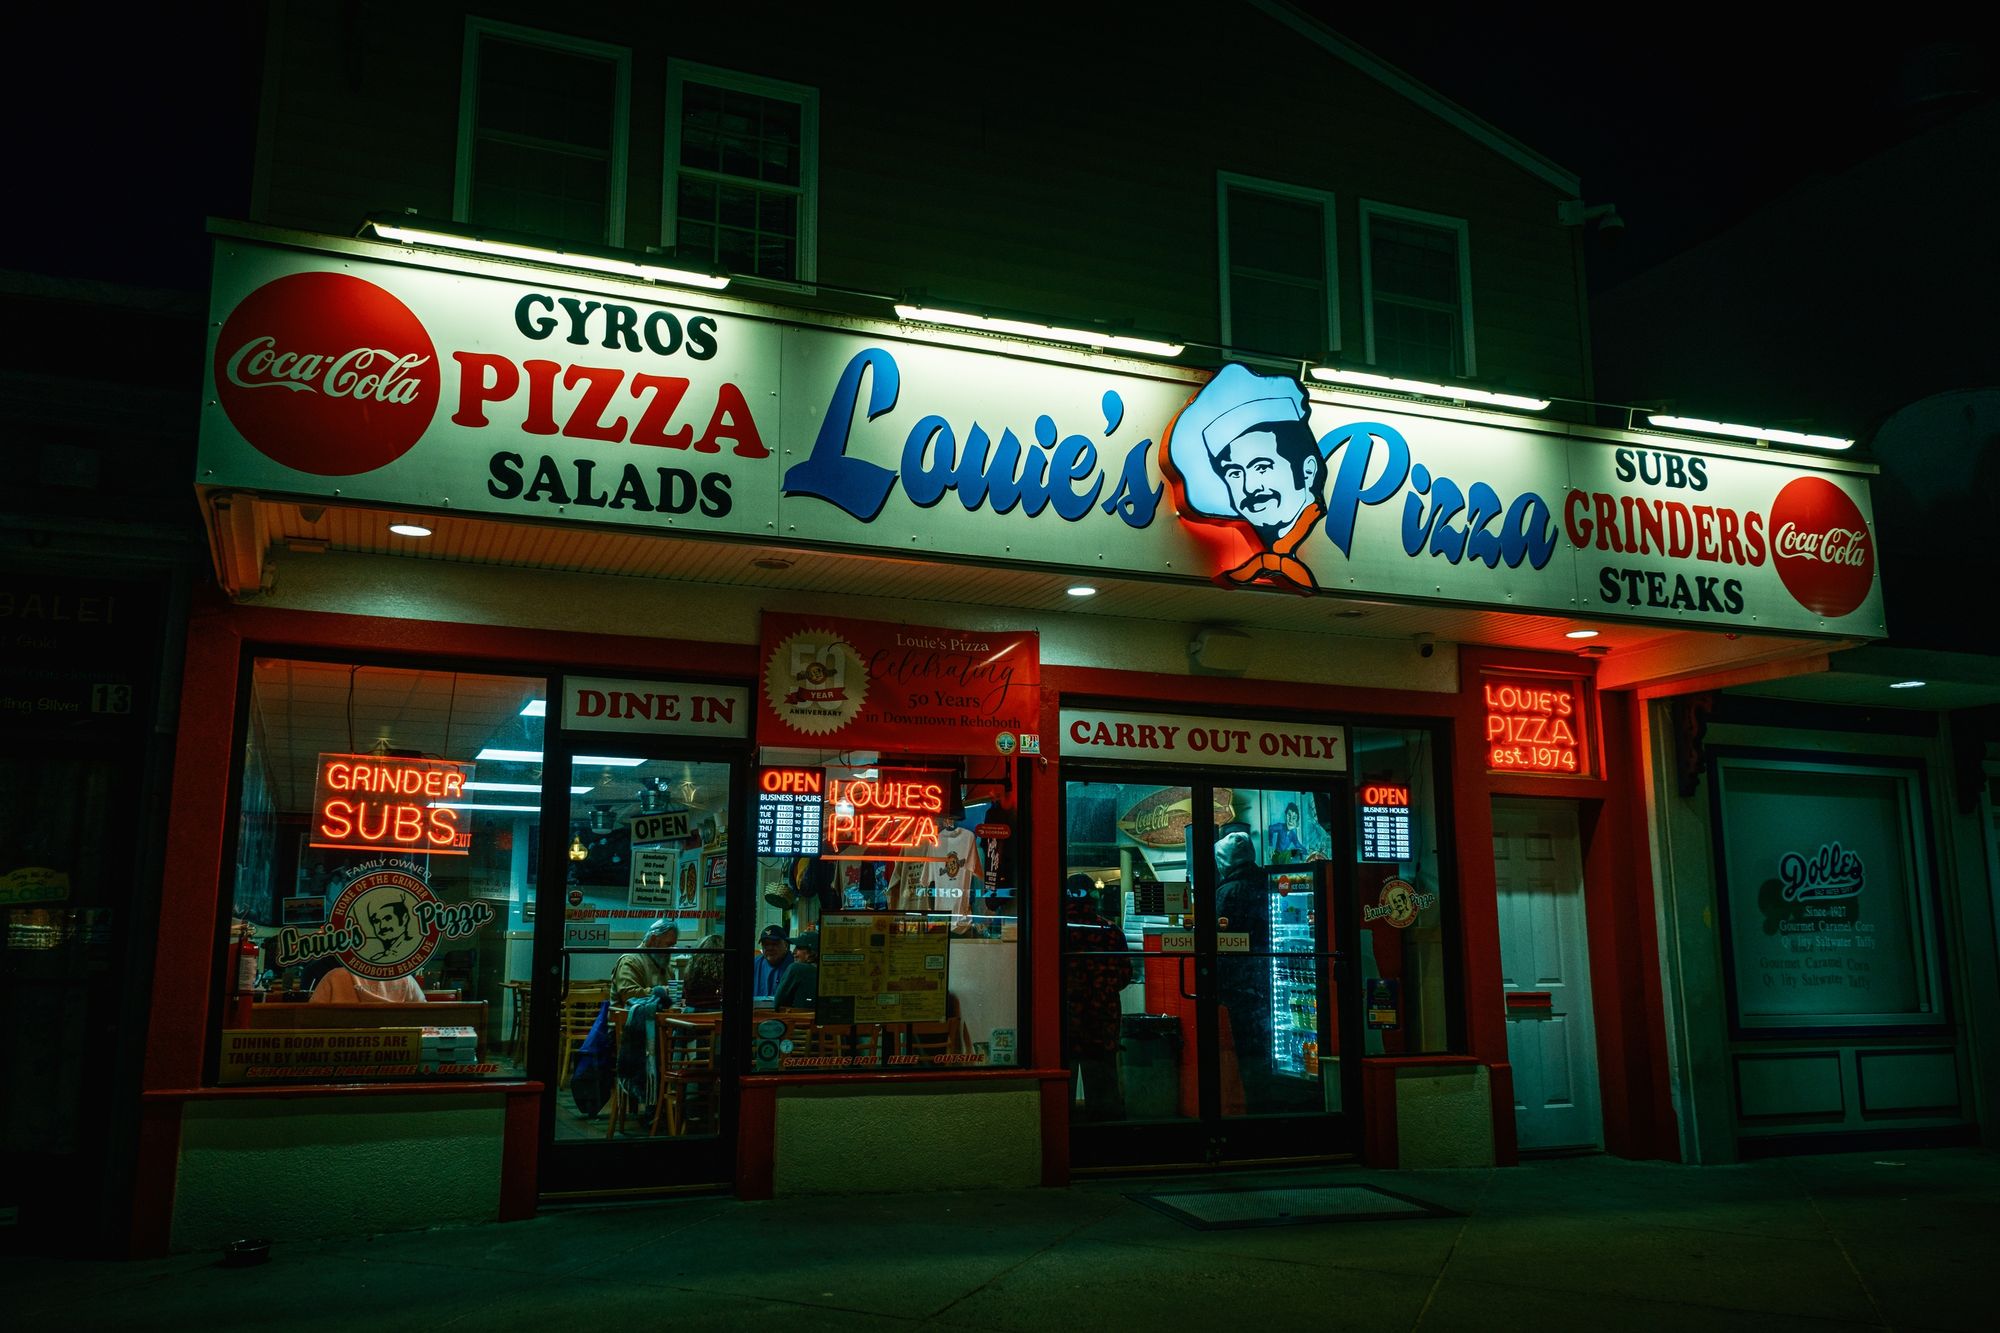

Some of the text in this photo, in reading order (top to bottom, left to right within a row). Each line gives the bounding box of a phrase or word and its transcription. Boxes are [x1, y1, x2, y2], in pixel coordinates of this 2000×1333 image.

[515, 294, 718, 360] GYROS
[226, 336, 429, 405] Coca-Cola
[451, 351, 770, 458] PIZZA
[781, 348, 1563, 570] Louie's Pizza
[1616, 447, 1708, 492] SUBS
[488, 451, 732, 518] SALADS
[1564, 489, 1766, 567] GRINDERS
[1775, 521, 1867, 567] Coca-Cola
[1599, 566, 1744, 615] STEAKS
[897, 634, 990, 652] Louie's Pizza
[870, 649, 1036, 714] Celebrating
[96, 687, 127, 712] 13
[577, 689, 735, 724] DINE IN
[810, 691, 834, 699] YEAR
[908, 690, 980, 710] 50 Years
[1485, 684, 1573, 716] LOUIE'S
[789, 709, 842, 717] ANNIVERSARY
[865, 711, 1021, 730] in Downtown Rehoboth
[1070, 720, 1180, 751] CARRY
[1187, 727, 1250, 754] OUT
[1259, 732, 1338, 760] ONLY
[1485, 715, 1577, 746] PIZZA
[1532, 748, 1577, 768] 1974
[326, 764, 463, 798] GRINDER
[763, 771, 821, 793] OPEN
[760, 793, 822, 802] BUSINESS HOURS
[830, 779, 942, 813] LOUIES
[1365, 786, 1408, 805] OPEN
[321, 801, 458, 846] SUBS
[635, 814, 688, 839] OPEN
[831, 814, 940, 852] PIZZA
[453, 833, 472, 847] EXIT
[345, 858, 432, 880] FAMILY OWNED
[334, 875, 428, 916] HOME OF THE GRINDER
[1409, 893, 1434, 908] Pizza
[1805, 906, 1827, 917] Since
[279, 900, 493, 965] Louie's Pizza
[569, 929, 606, 941] PUSH
[1779, 920, 1816, 932] Gourmet
[1818, 920, 1852, 932] Caramel
[423, 941, 435, 954] DE
[1164, 936, 1192, 948] PUSH
[1219, 936, 1247, 948] PUSH
[1815, 935, 1852, 948] Saltwater
[232, 1036, 408, 1049] DINING ROOM ORDERS ARE
[228, 1052, 270, 1065] TAKEN
[275, 1052, 292, 1064] BY
[296, 1051, 330, 1063] WAIT
[334, 1051, 372, 1062] STAFF
[933, 1053, 985, 1063] OUTSIDE
